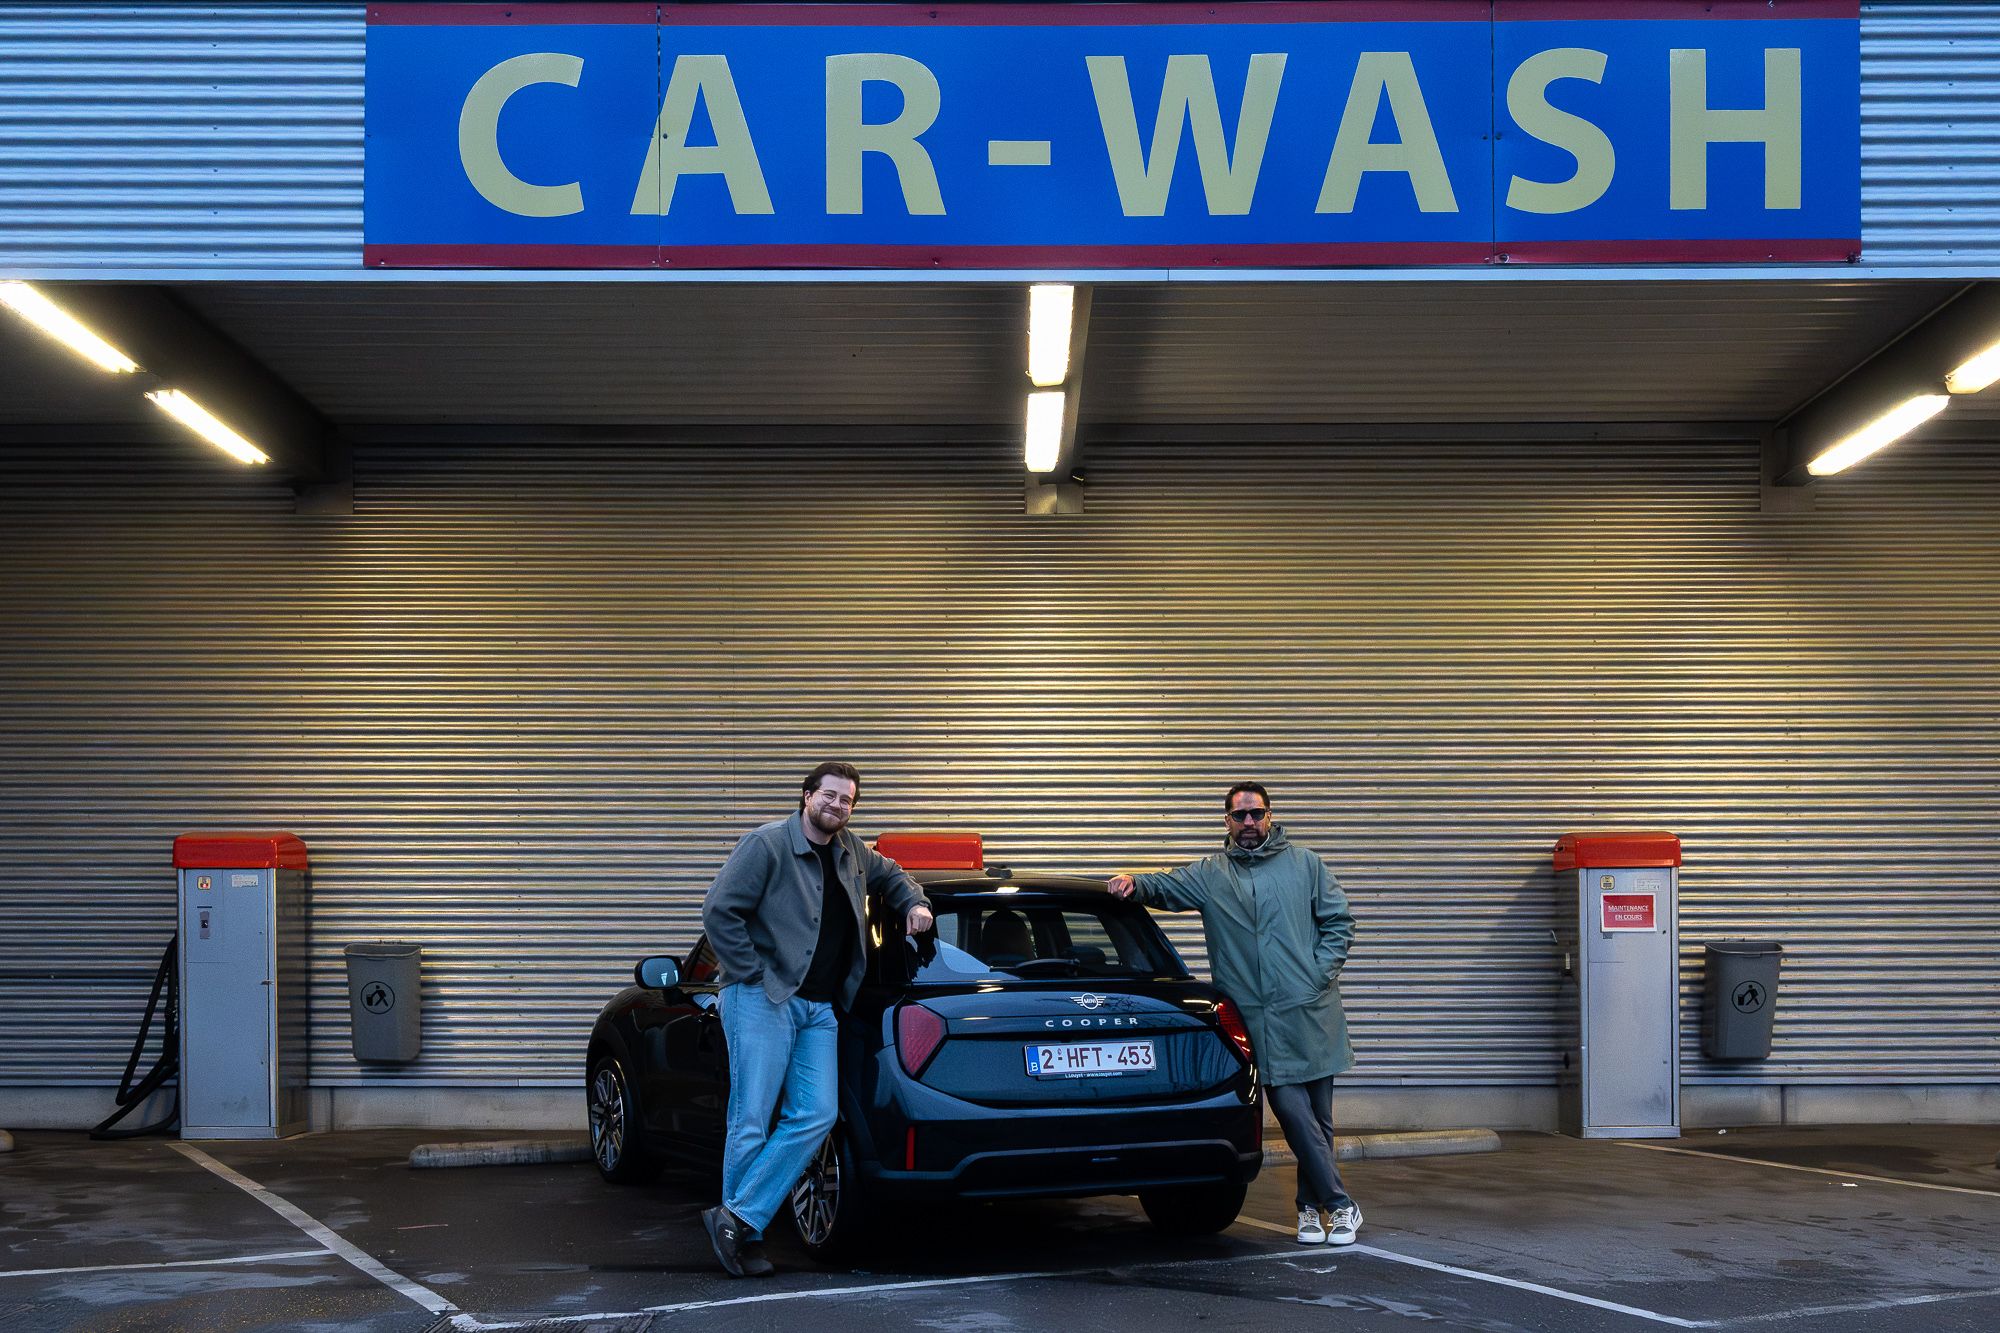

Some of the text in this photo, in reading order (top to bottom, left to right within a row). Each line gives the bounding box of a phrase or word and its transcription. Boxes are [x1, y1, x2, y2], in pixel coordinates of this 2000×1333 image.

[458, 46, 1801, 218] CAR-WASH
[1045, 1017, 1138, 1028] COOPER
[1031, 1062, 1039, 1072] B
